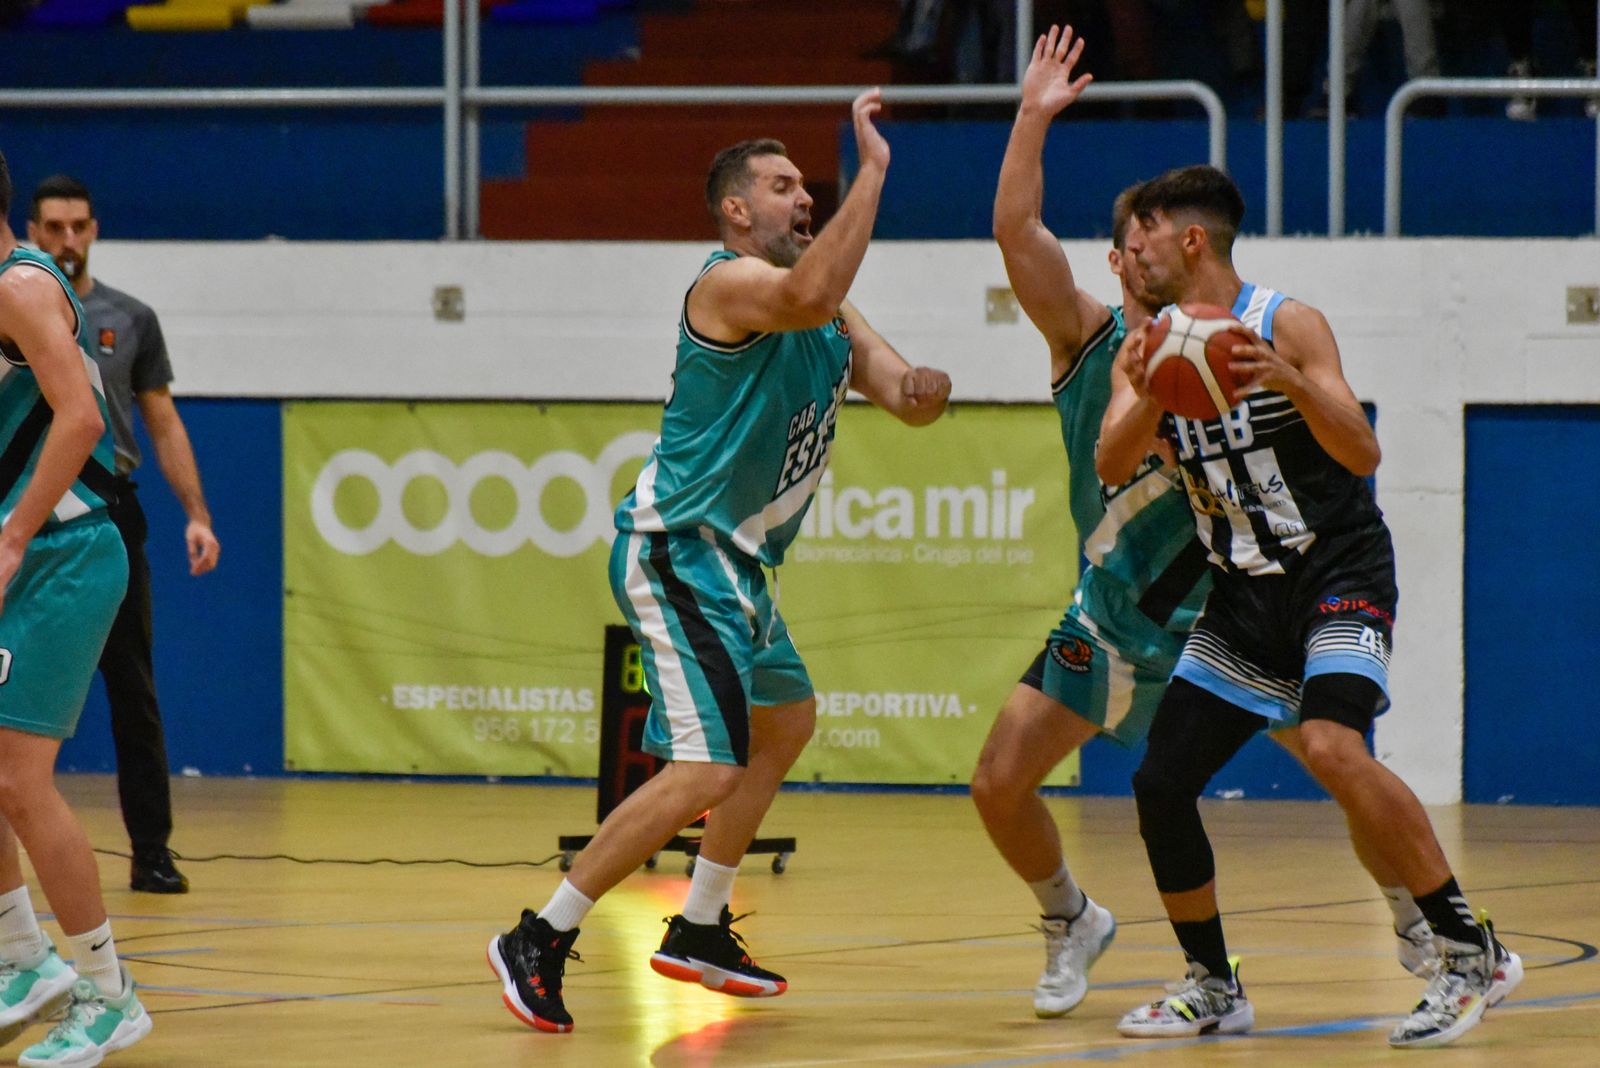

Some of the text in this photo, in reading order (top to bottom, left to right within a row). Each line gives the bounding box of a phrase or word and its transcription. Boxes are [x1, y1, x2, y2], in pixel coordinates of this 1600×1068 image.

[788, 401, 817, 441] CAB
[924, 468, 1036, 540] mir
[393, 684, 594, 712] ESPECIALISTAS
[474, 716, 600, 743] 956 172 5
